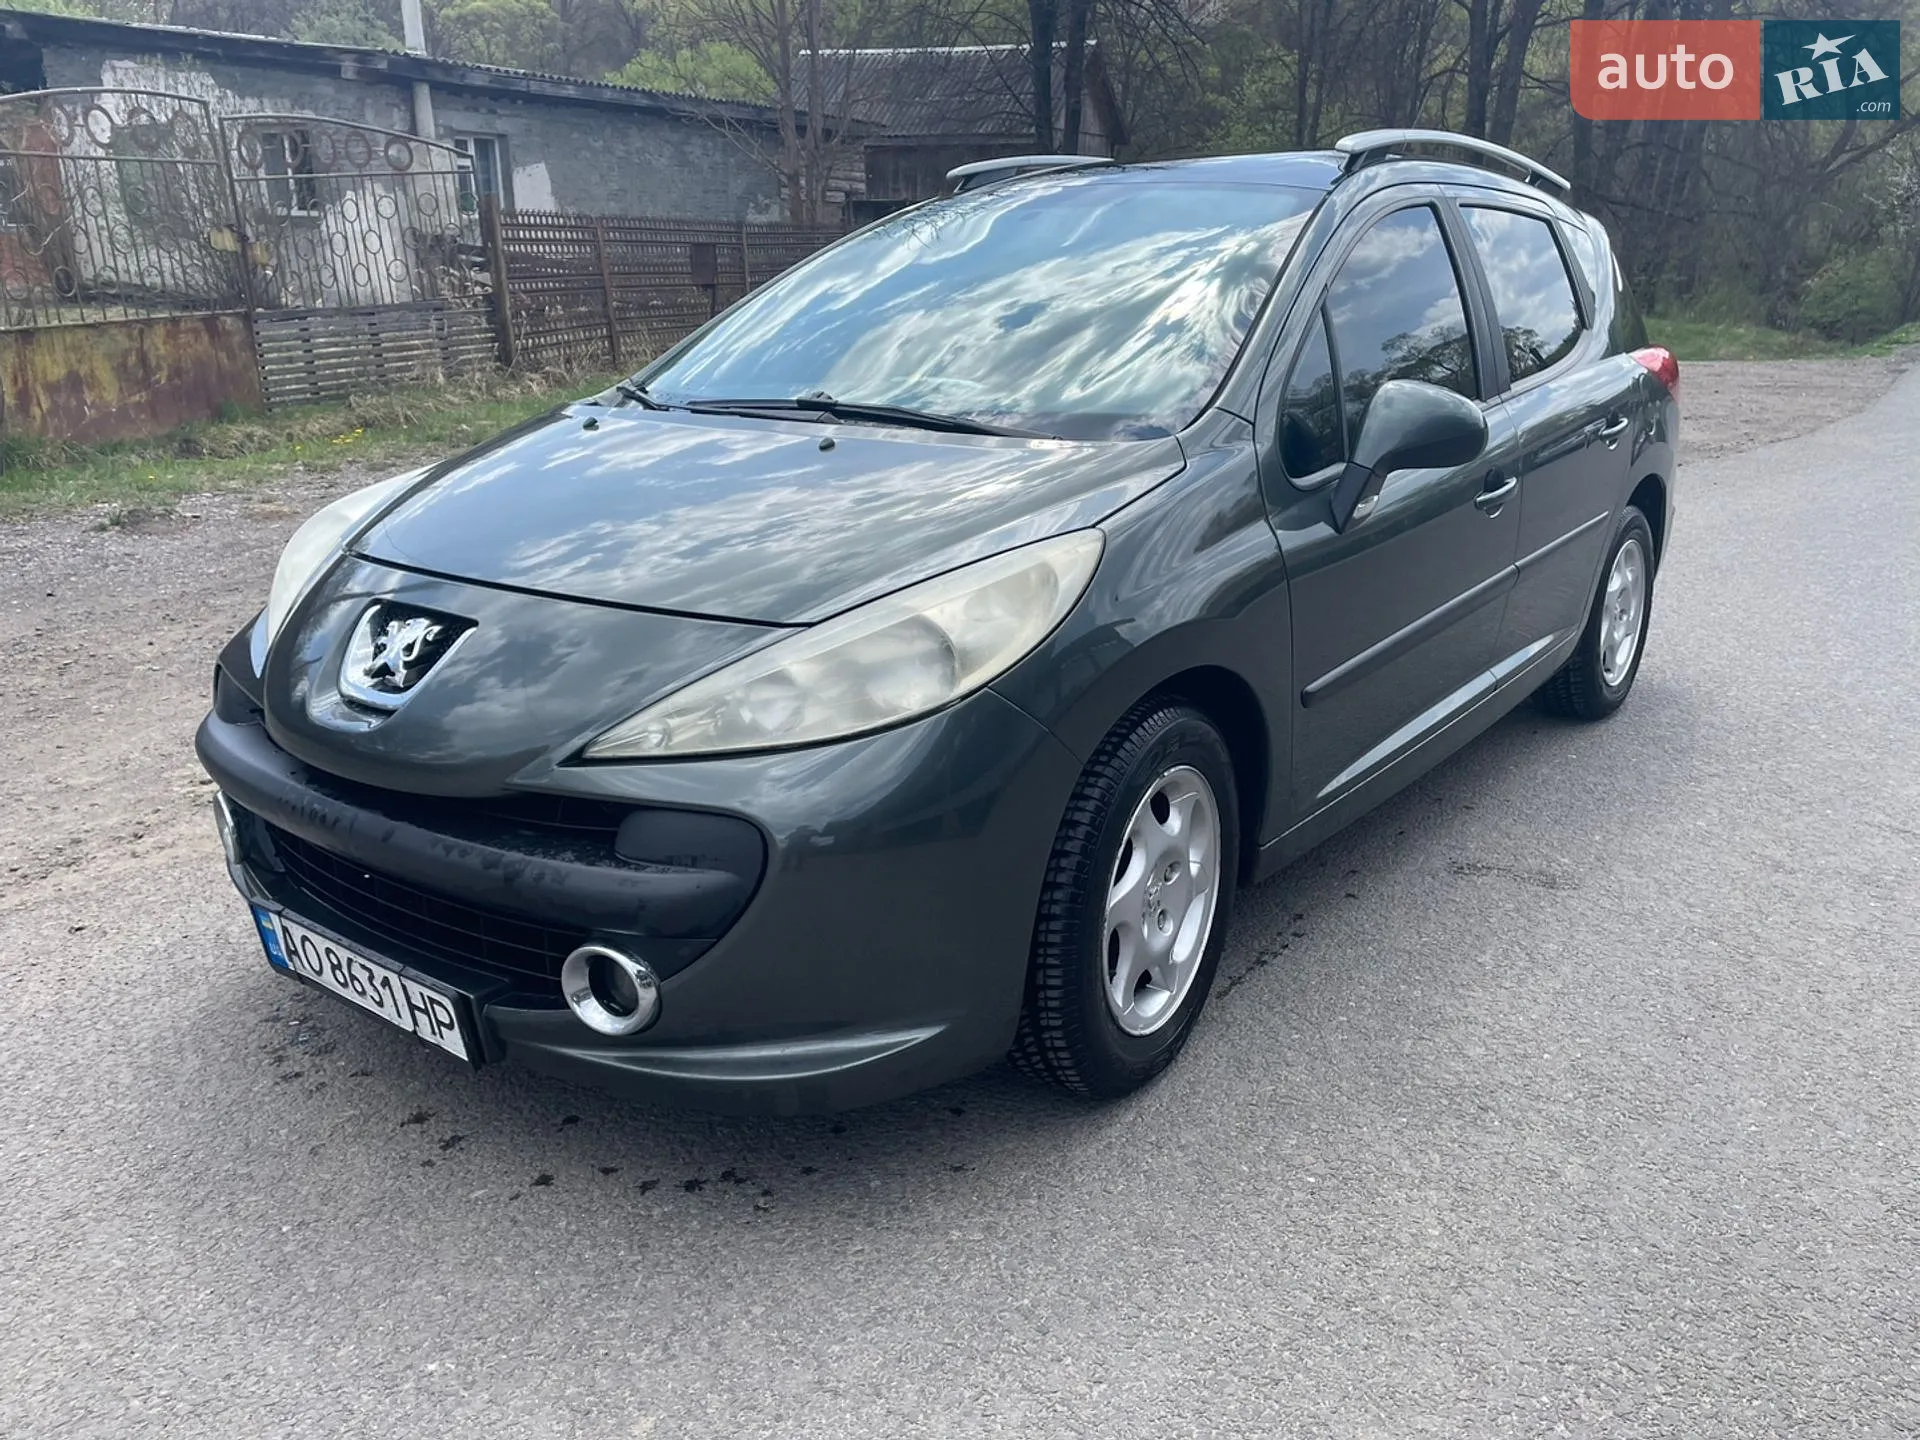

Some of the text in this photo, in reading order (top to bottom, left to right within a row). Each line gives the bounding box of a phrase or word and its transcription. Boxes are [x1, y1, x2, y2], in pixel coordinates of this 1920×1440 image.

[281, 925, 455, 1039] AO 8631 HP
